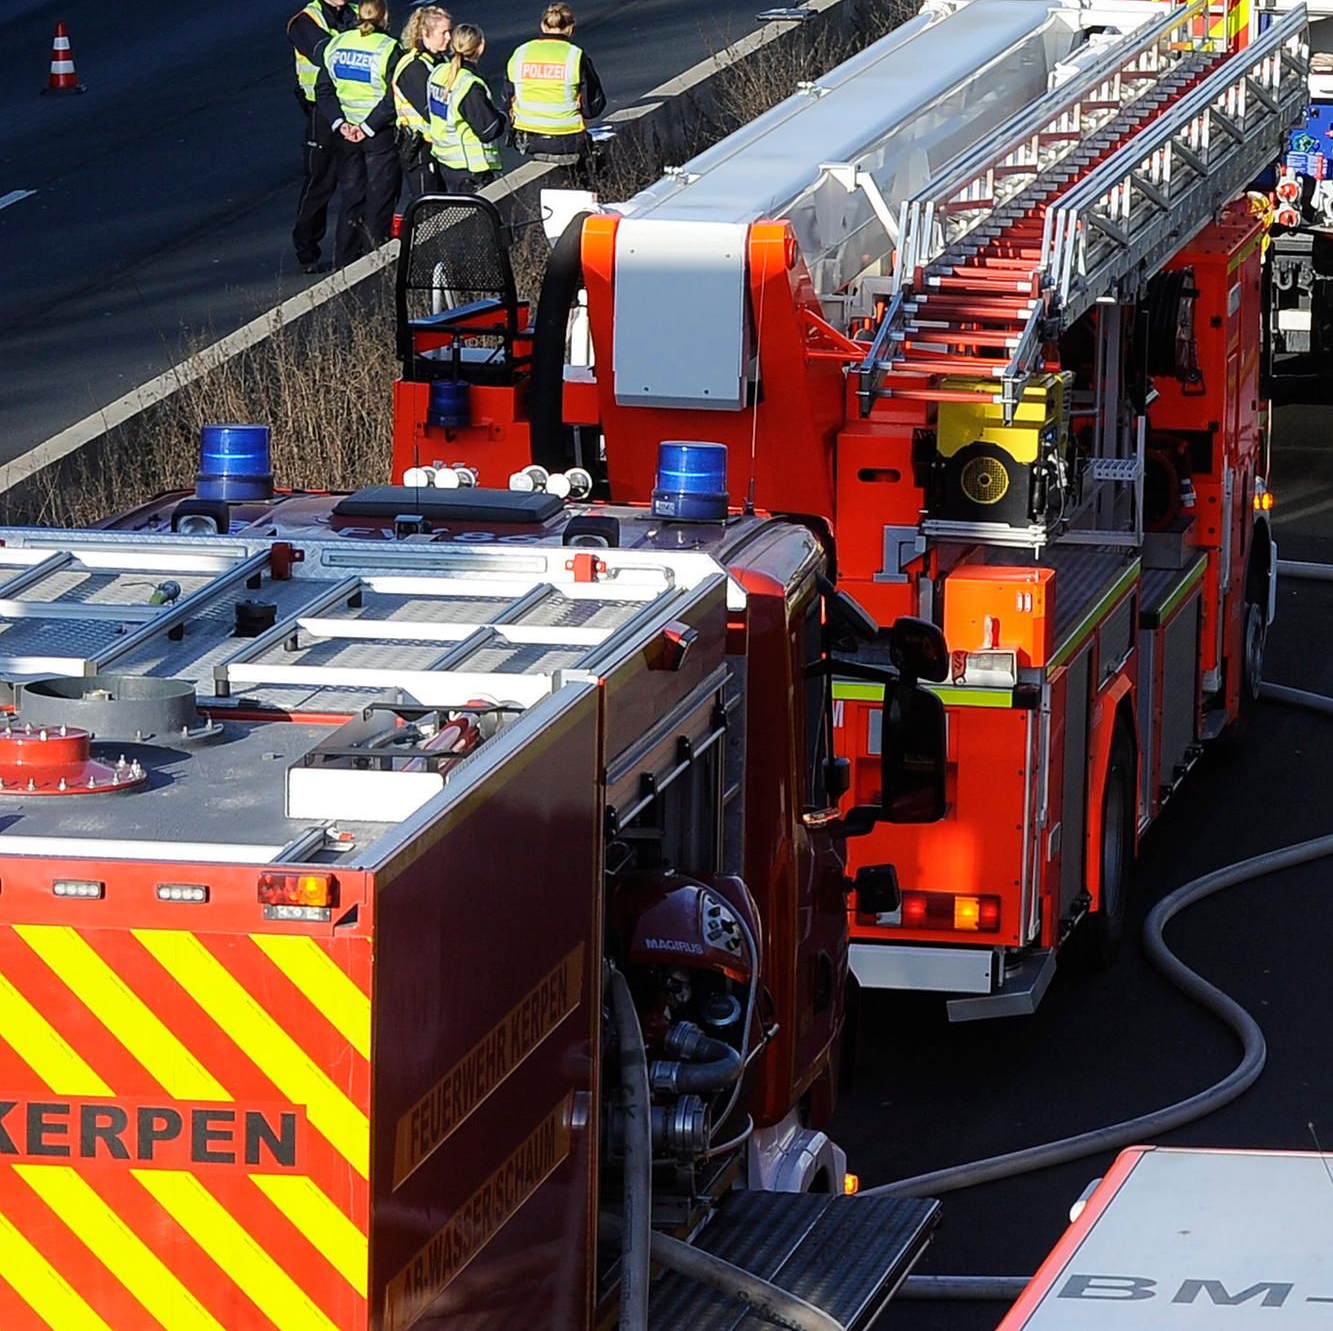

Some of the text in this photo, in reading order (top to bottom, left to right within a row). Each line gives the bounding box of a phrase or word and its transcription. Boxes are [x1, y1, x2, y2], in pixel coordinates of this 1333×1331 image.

[334, 50, 373, 68] POLIZEI
[522, 63, 568, 79] POLIZEI
[645, 938, 704, 955] MAGIRUS
[410, 961, 570, 1167] FEUERWEHR KERPEN
